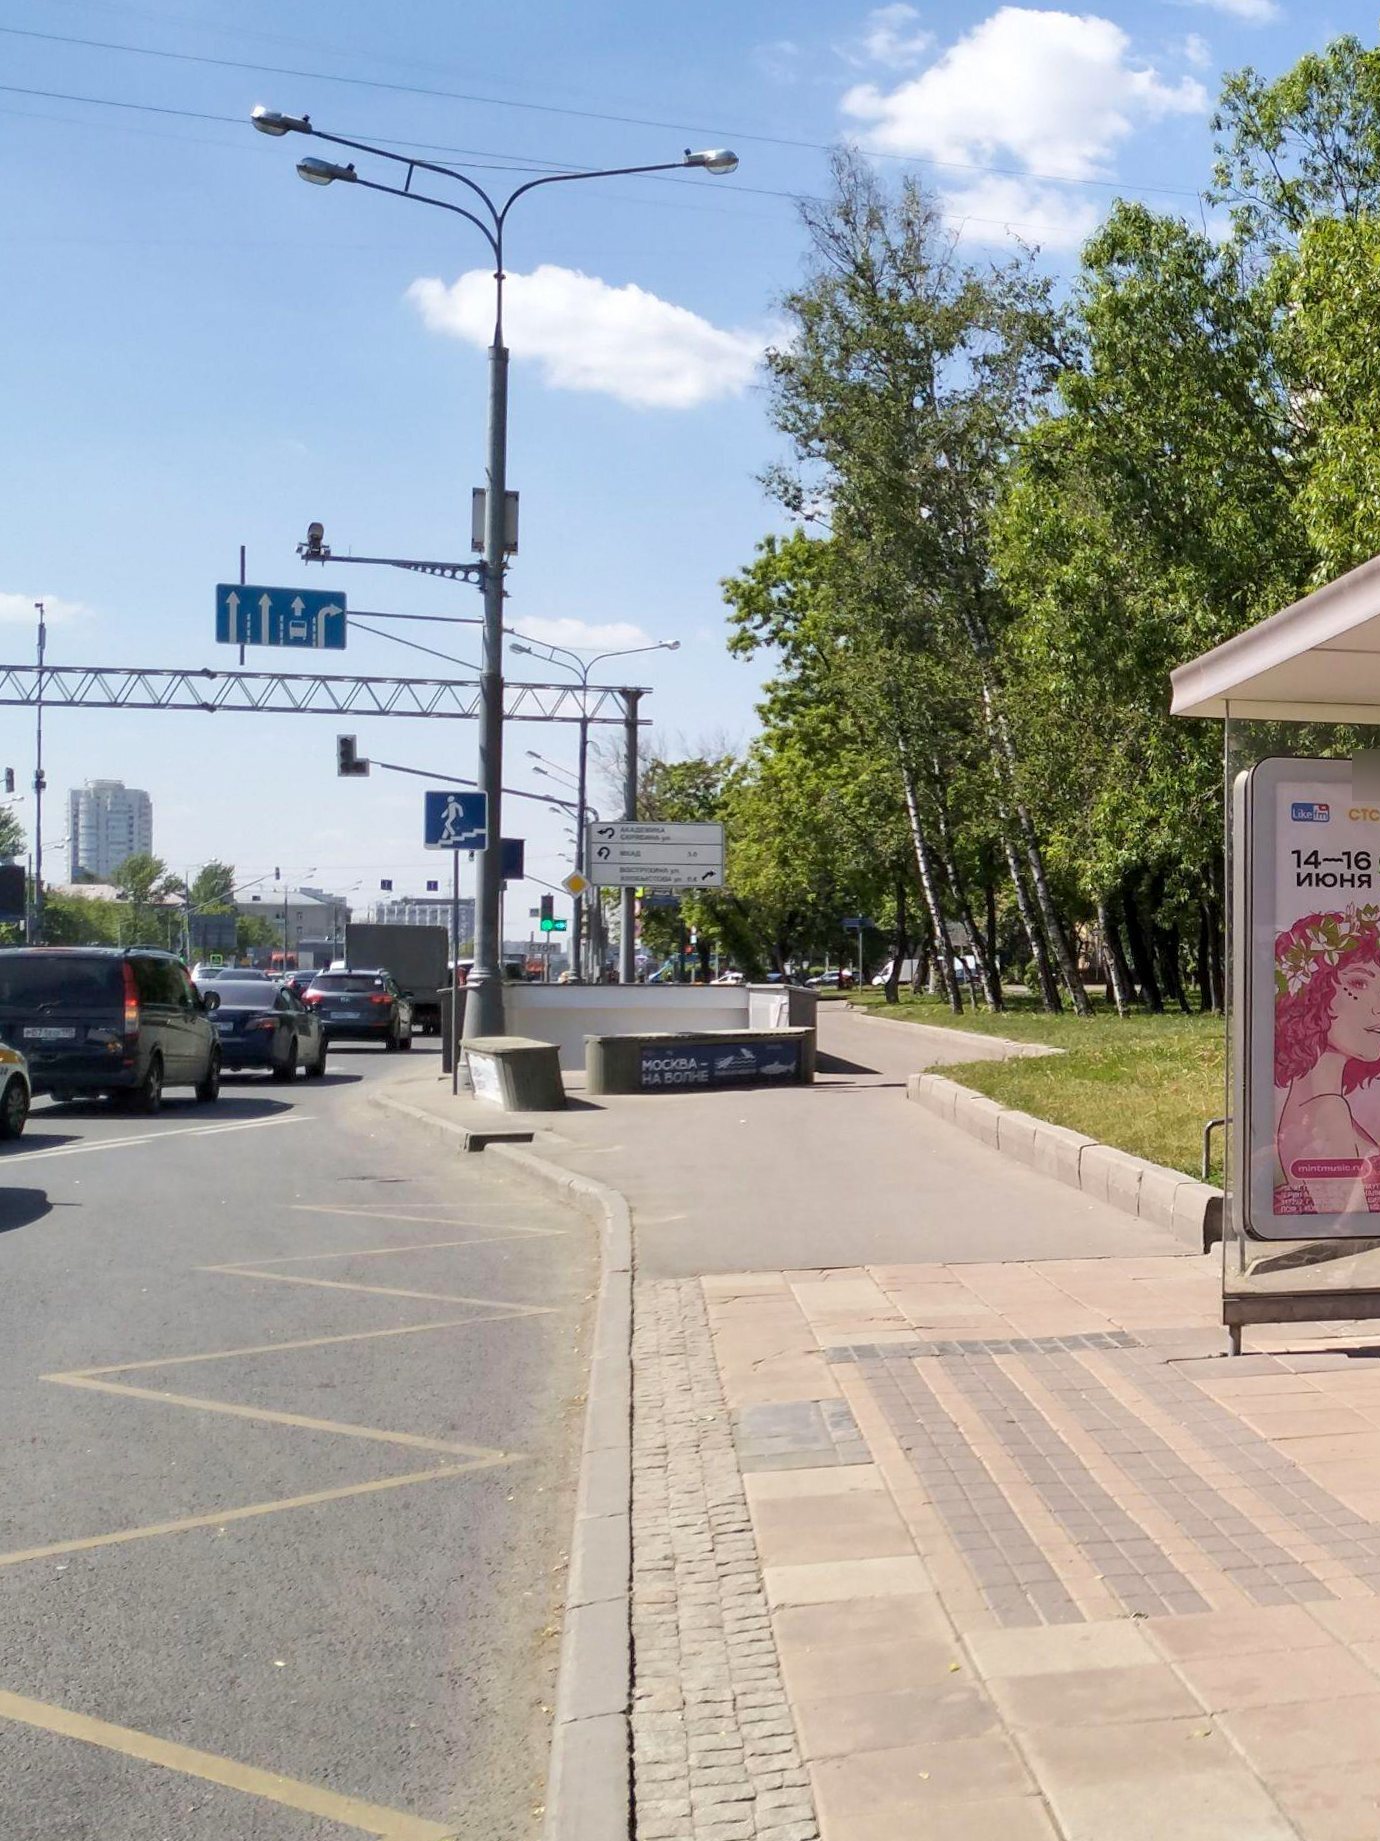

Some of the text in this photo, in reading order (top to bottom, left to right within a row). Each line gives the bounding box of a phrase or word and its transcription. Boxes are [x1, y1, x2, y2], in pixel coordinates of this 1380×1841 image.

[1292, 806, 1313, 820] Like
[1349, 808, 1380, 821] СТС
[1296, 872, 1372, 889] ИЮНЯ
[642, 1058, 697, 1071] МОСКВА
[642, 1073, 661, 1084] НА
[664, 1070, 709, 1083] ВОЛНЕ
[1298, 1164, 1364, 1173] mintmusic.ru
